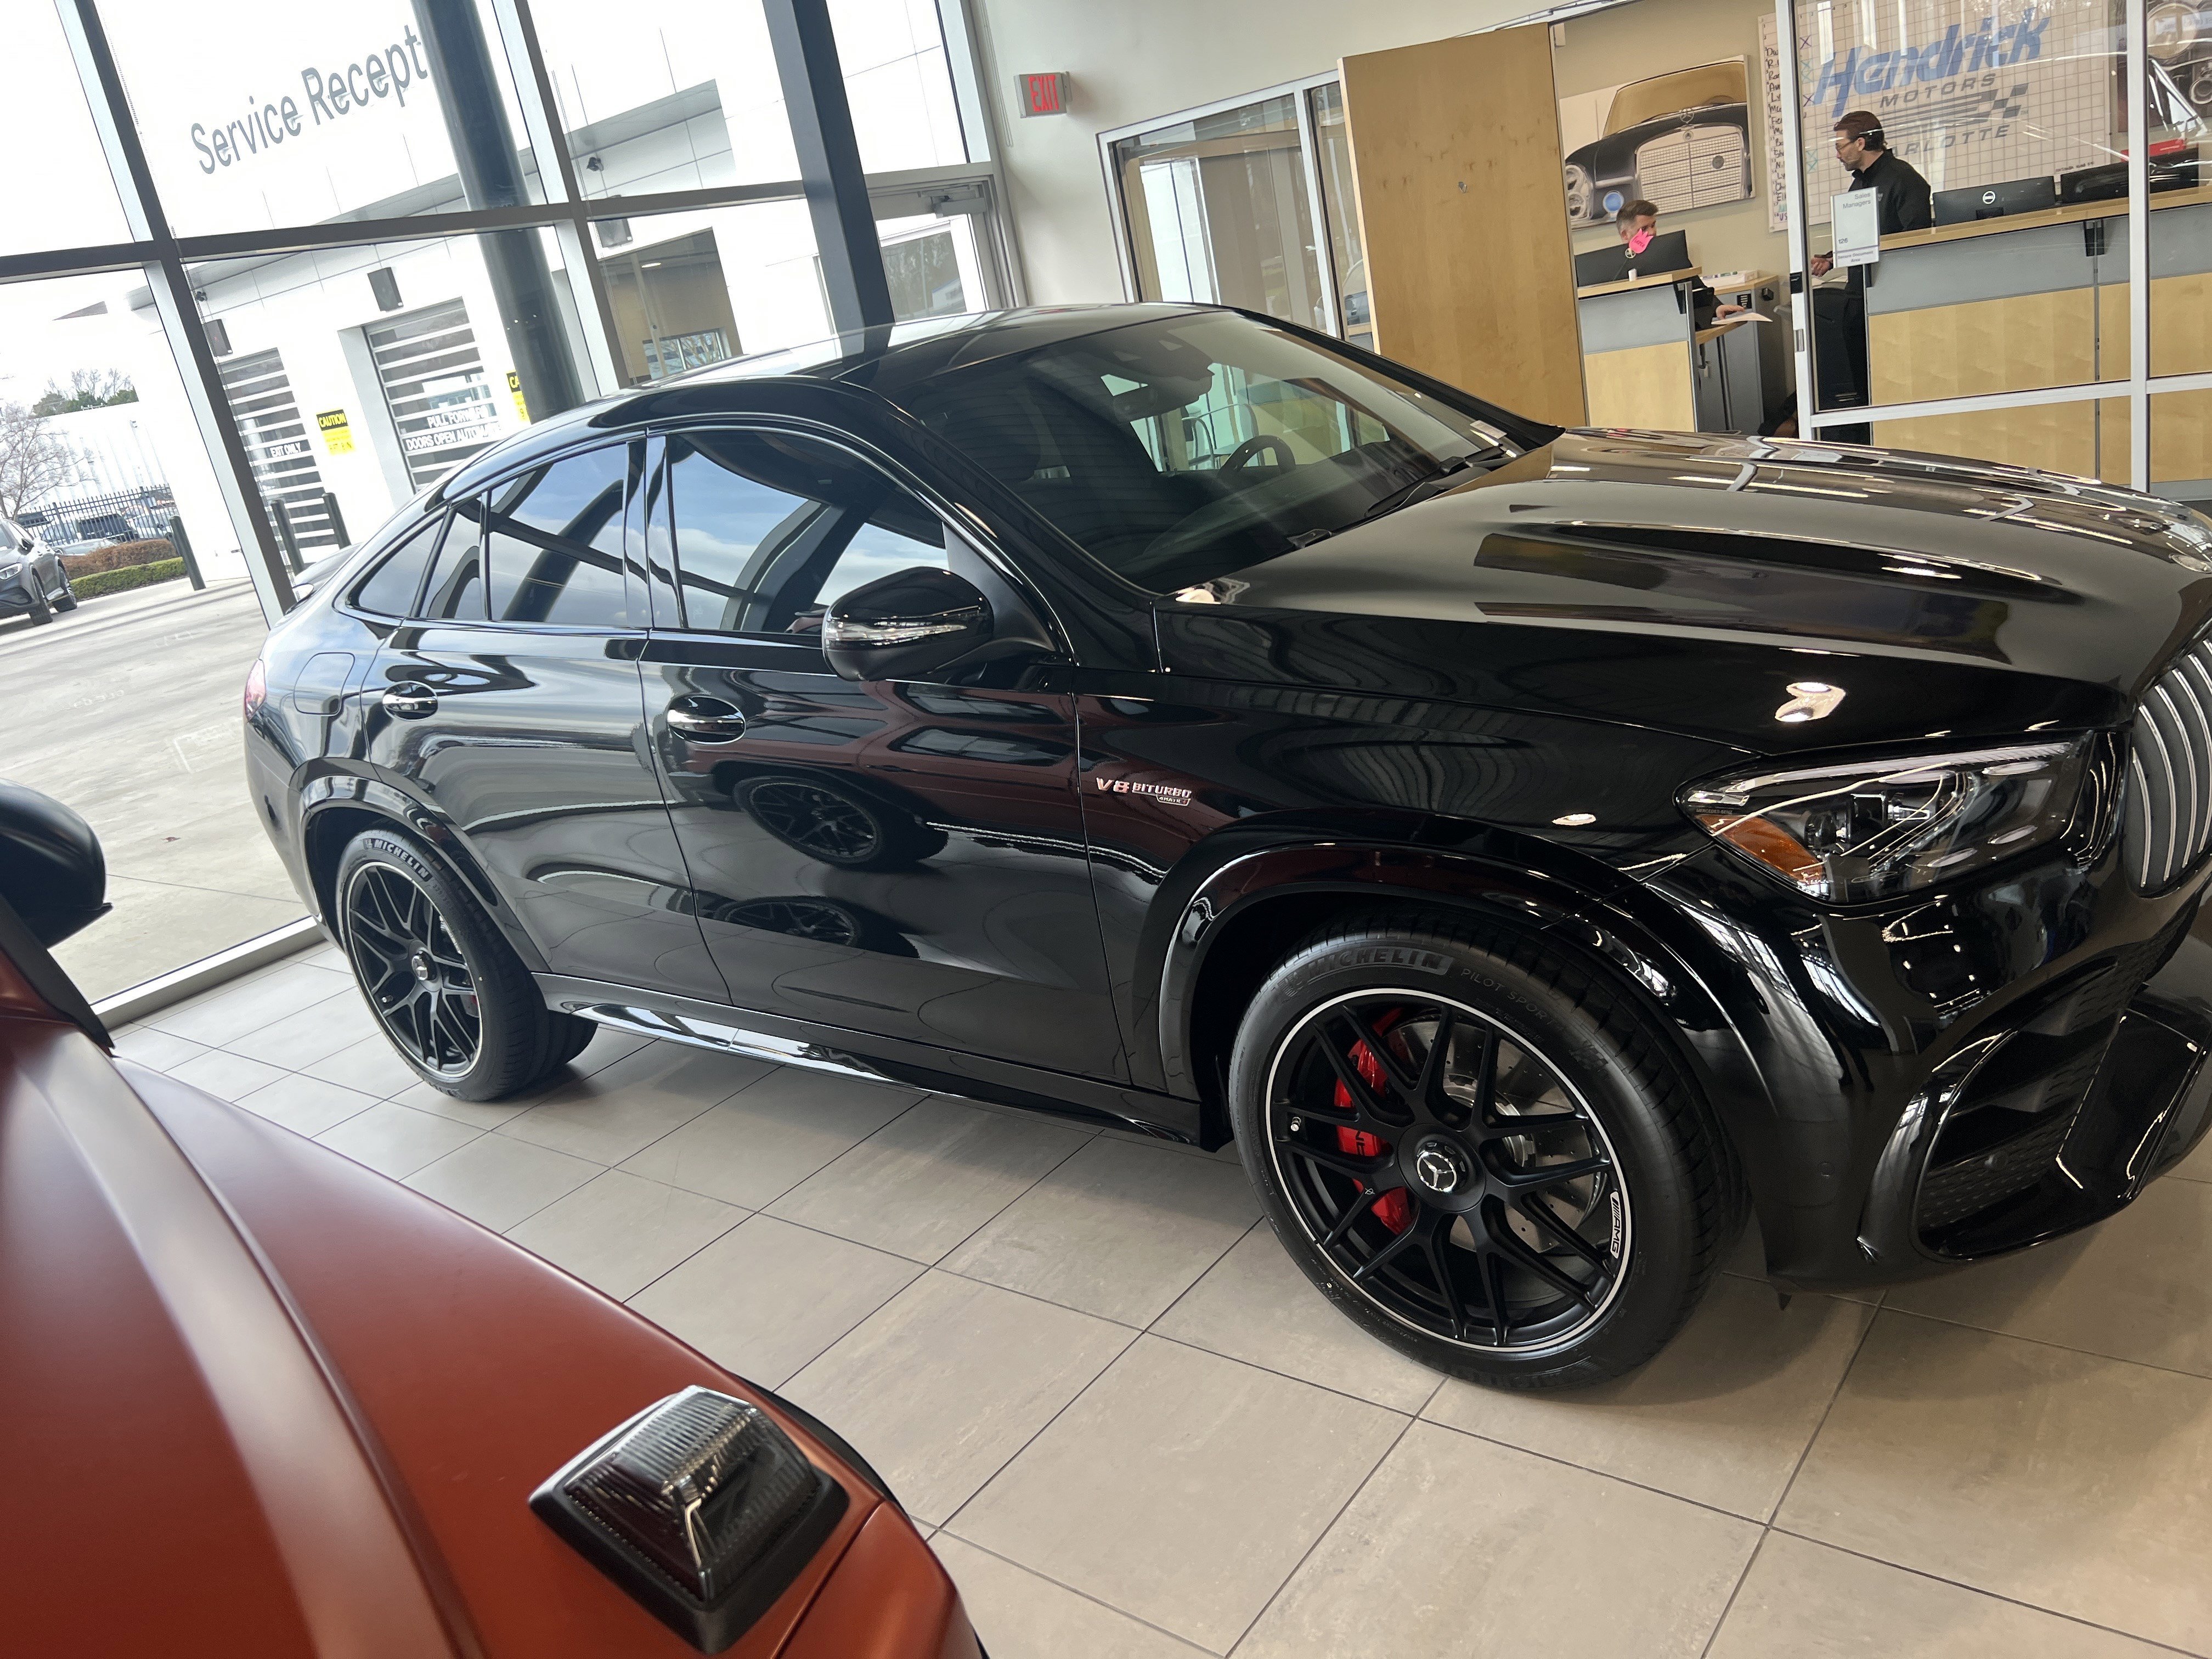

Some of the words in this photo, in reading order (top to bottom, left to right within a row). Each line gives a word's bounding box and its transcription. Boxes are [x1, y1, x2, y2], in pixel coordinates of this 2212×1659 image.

[1813, 7, 2050, 118] Hendrick
[191, 95, 301, 174] Service
[301, 24, 428, 126] Recept
[1028, 74, 1059, 112] EXIT
[1880, 73, 1996, 108] MOTORS
[1892, 125, 2010, 157] ARLOTTE
[1843, 200, 1871, 209] Managers
[318, 413, 347, 428] CAUTION
[427, 413, 449, 428] PULL
[269, 445, 285, 458] EXIT
[284, 442, 302, 455] ONLY
[406, 435, 434, 450] DOORS
[433, 430, 456, 445] OPEN
[1096, 777, 1130, 794] V8
[1132, 782, 1192, 799] BITURBO
[374, 839, 430, 878] MICHELIN
[1307, 948, 1444, 979] MICHELIN
[1460, 968, 1505, 991] PILOT
[1611, 1215, 1621, 1254] AMG
